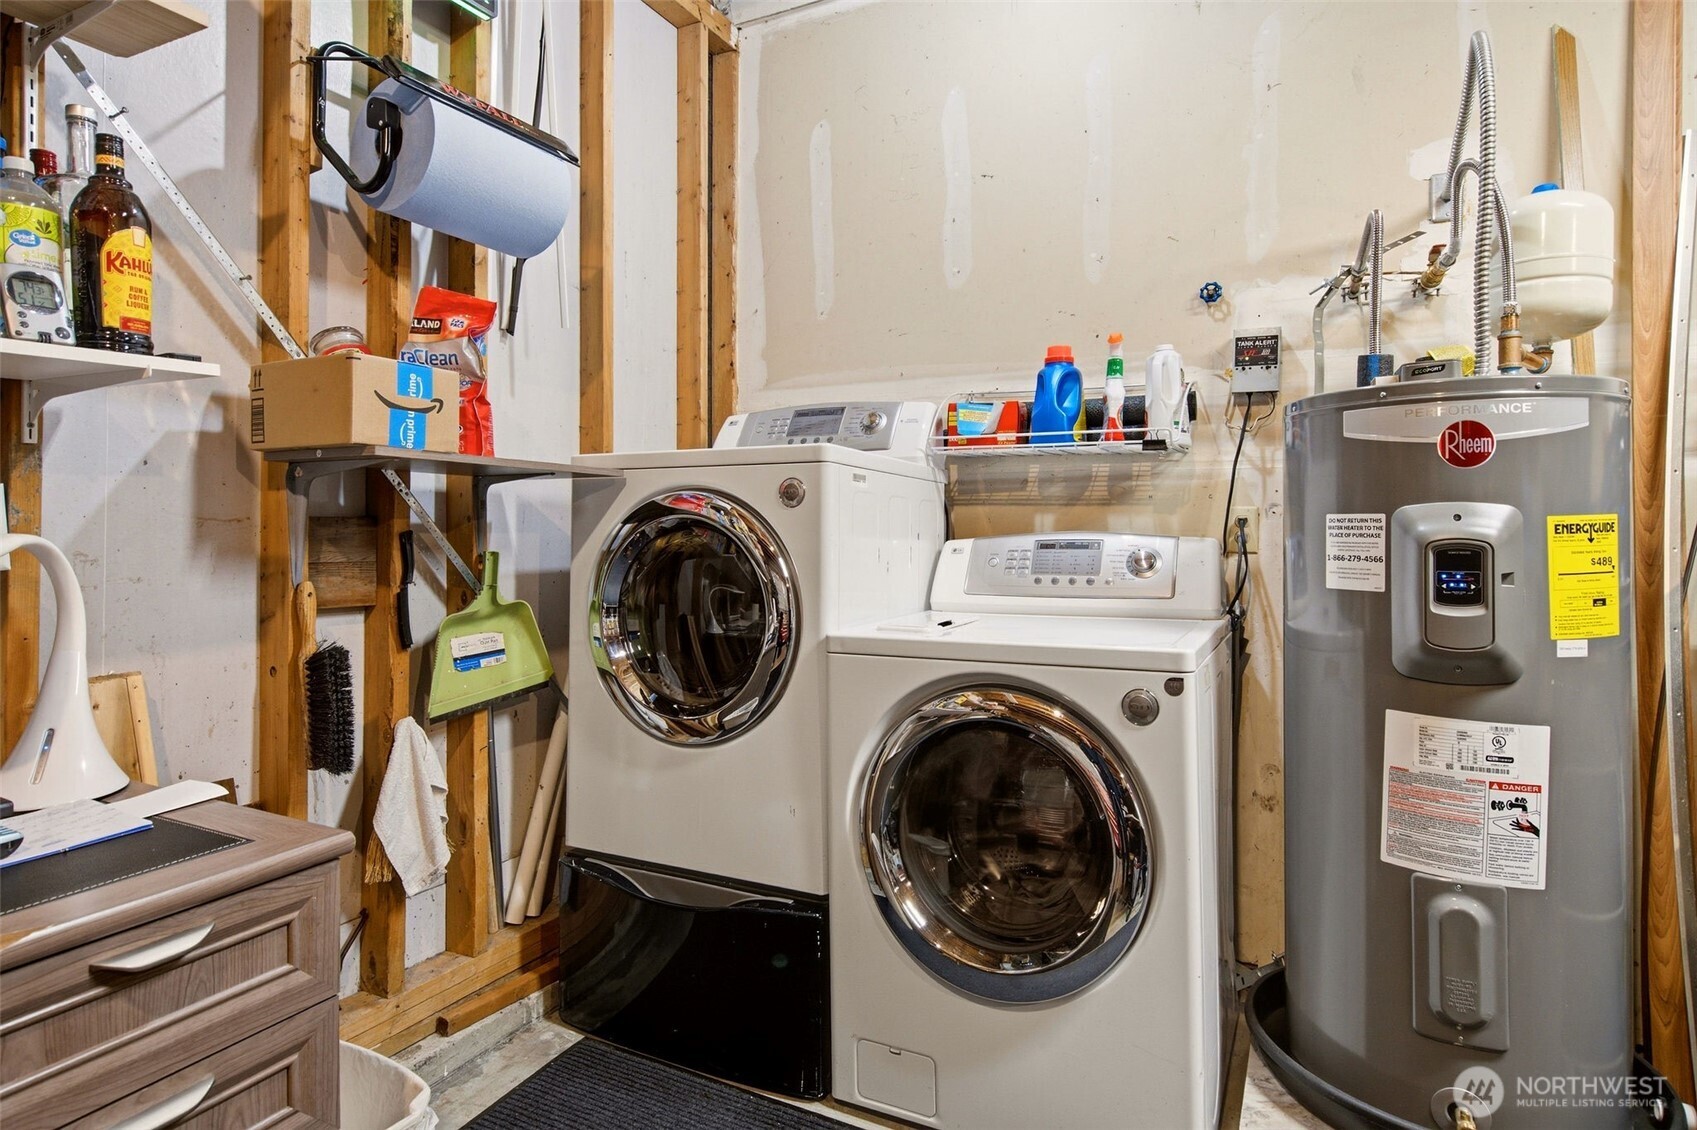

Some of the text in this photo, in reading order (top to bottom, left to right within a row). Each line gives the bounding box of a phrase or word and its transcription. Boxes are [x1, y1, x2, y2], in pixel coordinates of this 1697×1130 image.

[1414, 364, 1444, 375] ECOPORT
[1404, 402, 1532, 418] PERFORMANCE
[406, 419, 417, 449] prime
[1444, 420, 1493, 461] Rheem
[1327, 554, 1384, 563] 1-866-279-4566
[1502, 783, 1539, 793] DANGER
